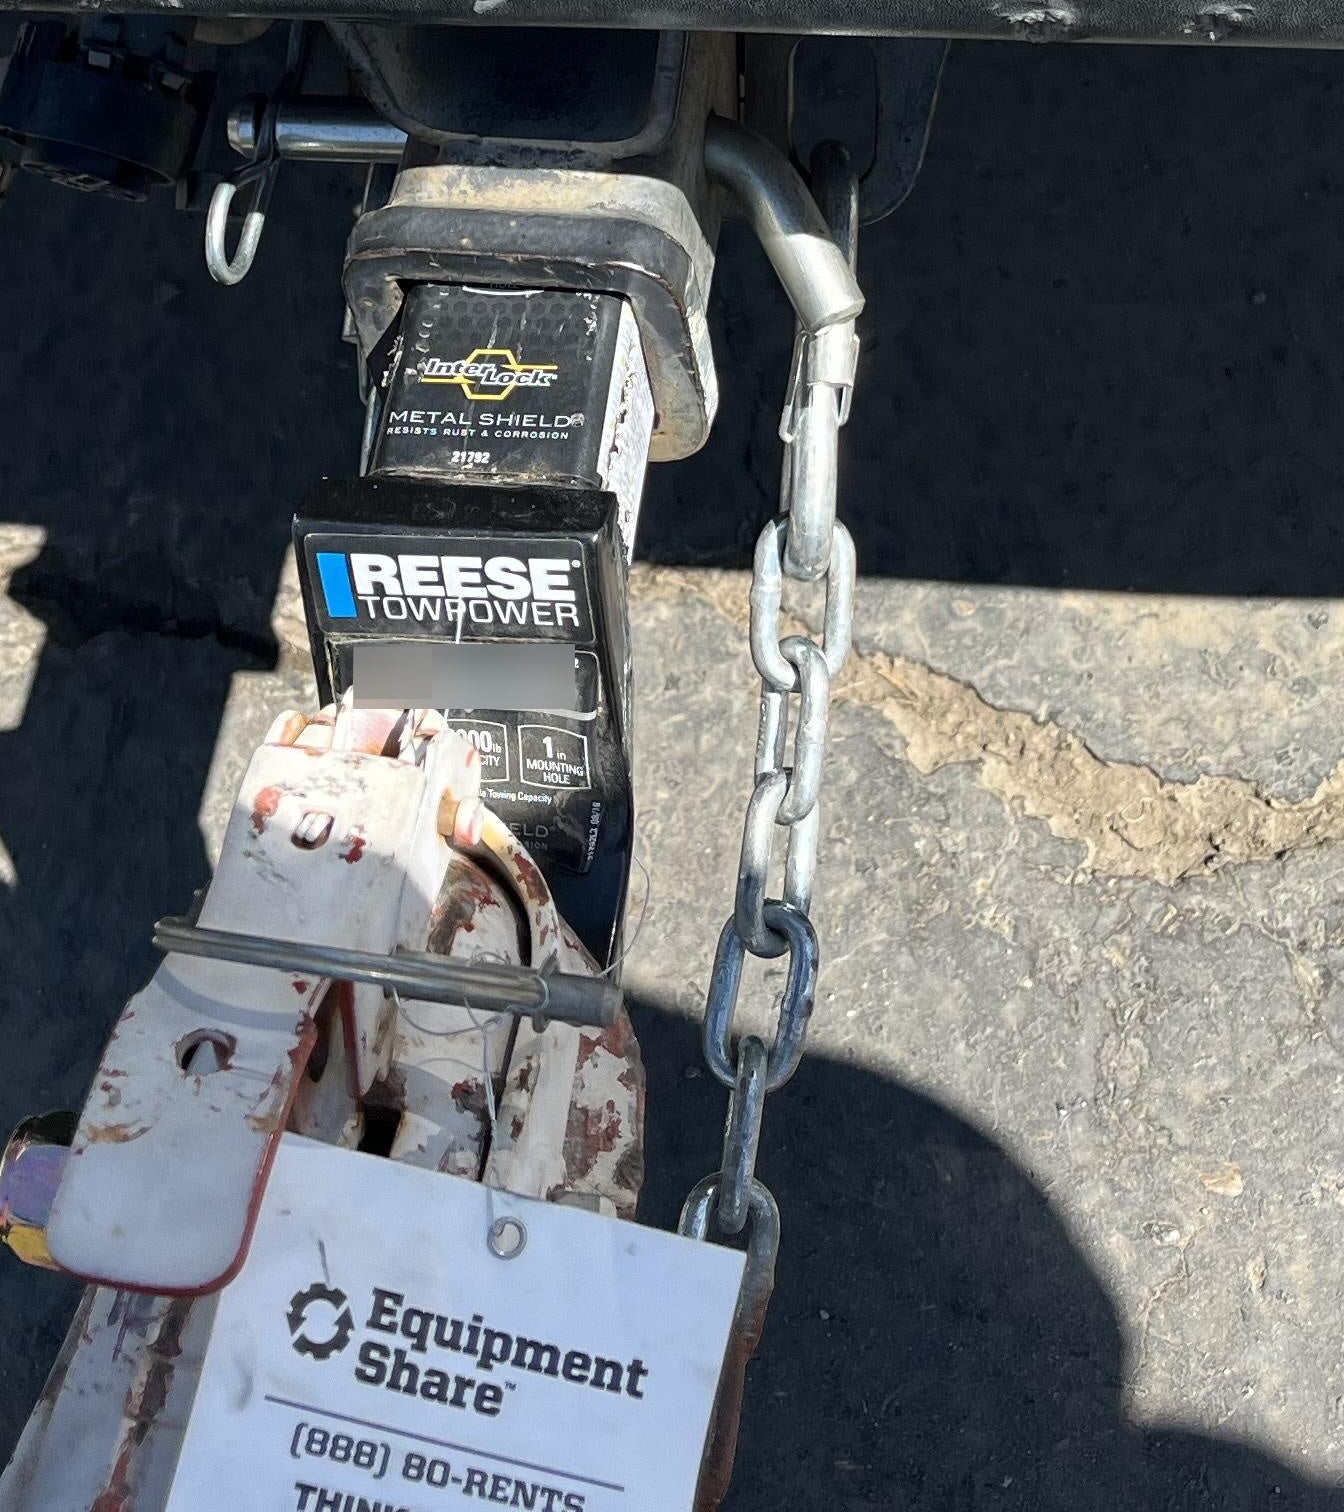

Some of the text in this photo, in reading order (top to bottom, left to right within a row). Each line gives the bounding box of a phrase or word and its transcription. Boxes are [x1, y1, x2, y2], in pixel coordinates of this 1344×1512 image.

[389, 410, 472, 425] METAL
[386, 427, 569, 440] RESISTS RUST & CORROSION
[451, 450, 491, 464] 21792
[357, 595, 580, 627] TOWPOWER
[542, 735, 553, 758] 1
[526, 758, 584, 777] MOUNTING
[543, 771, 571, 785] HOLE
[487, 787, 516, 802] Towing
[518, 791, 553, 806] Capacity
[365, 1286, 649, 1400] Equipment
[289, 1421, 587, 1512] (888) 80-RENTS
